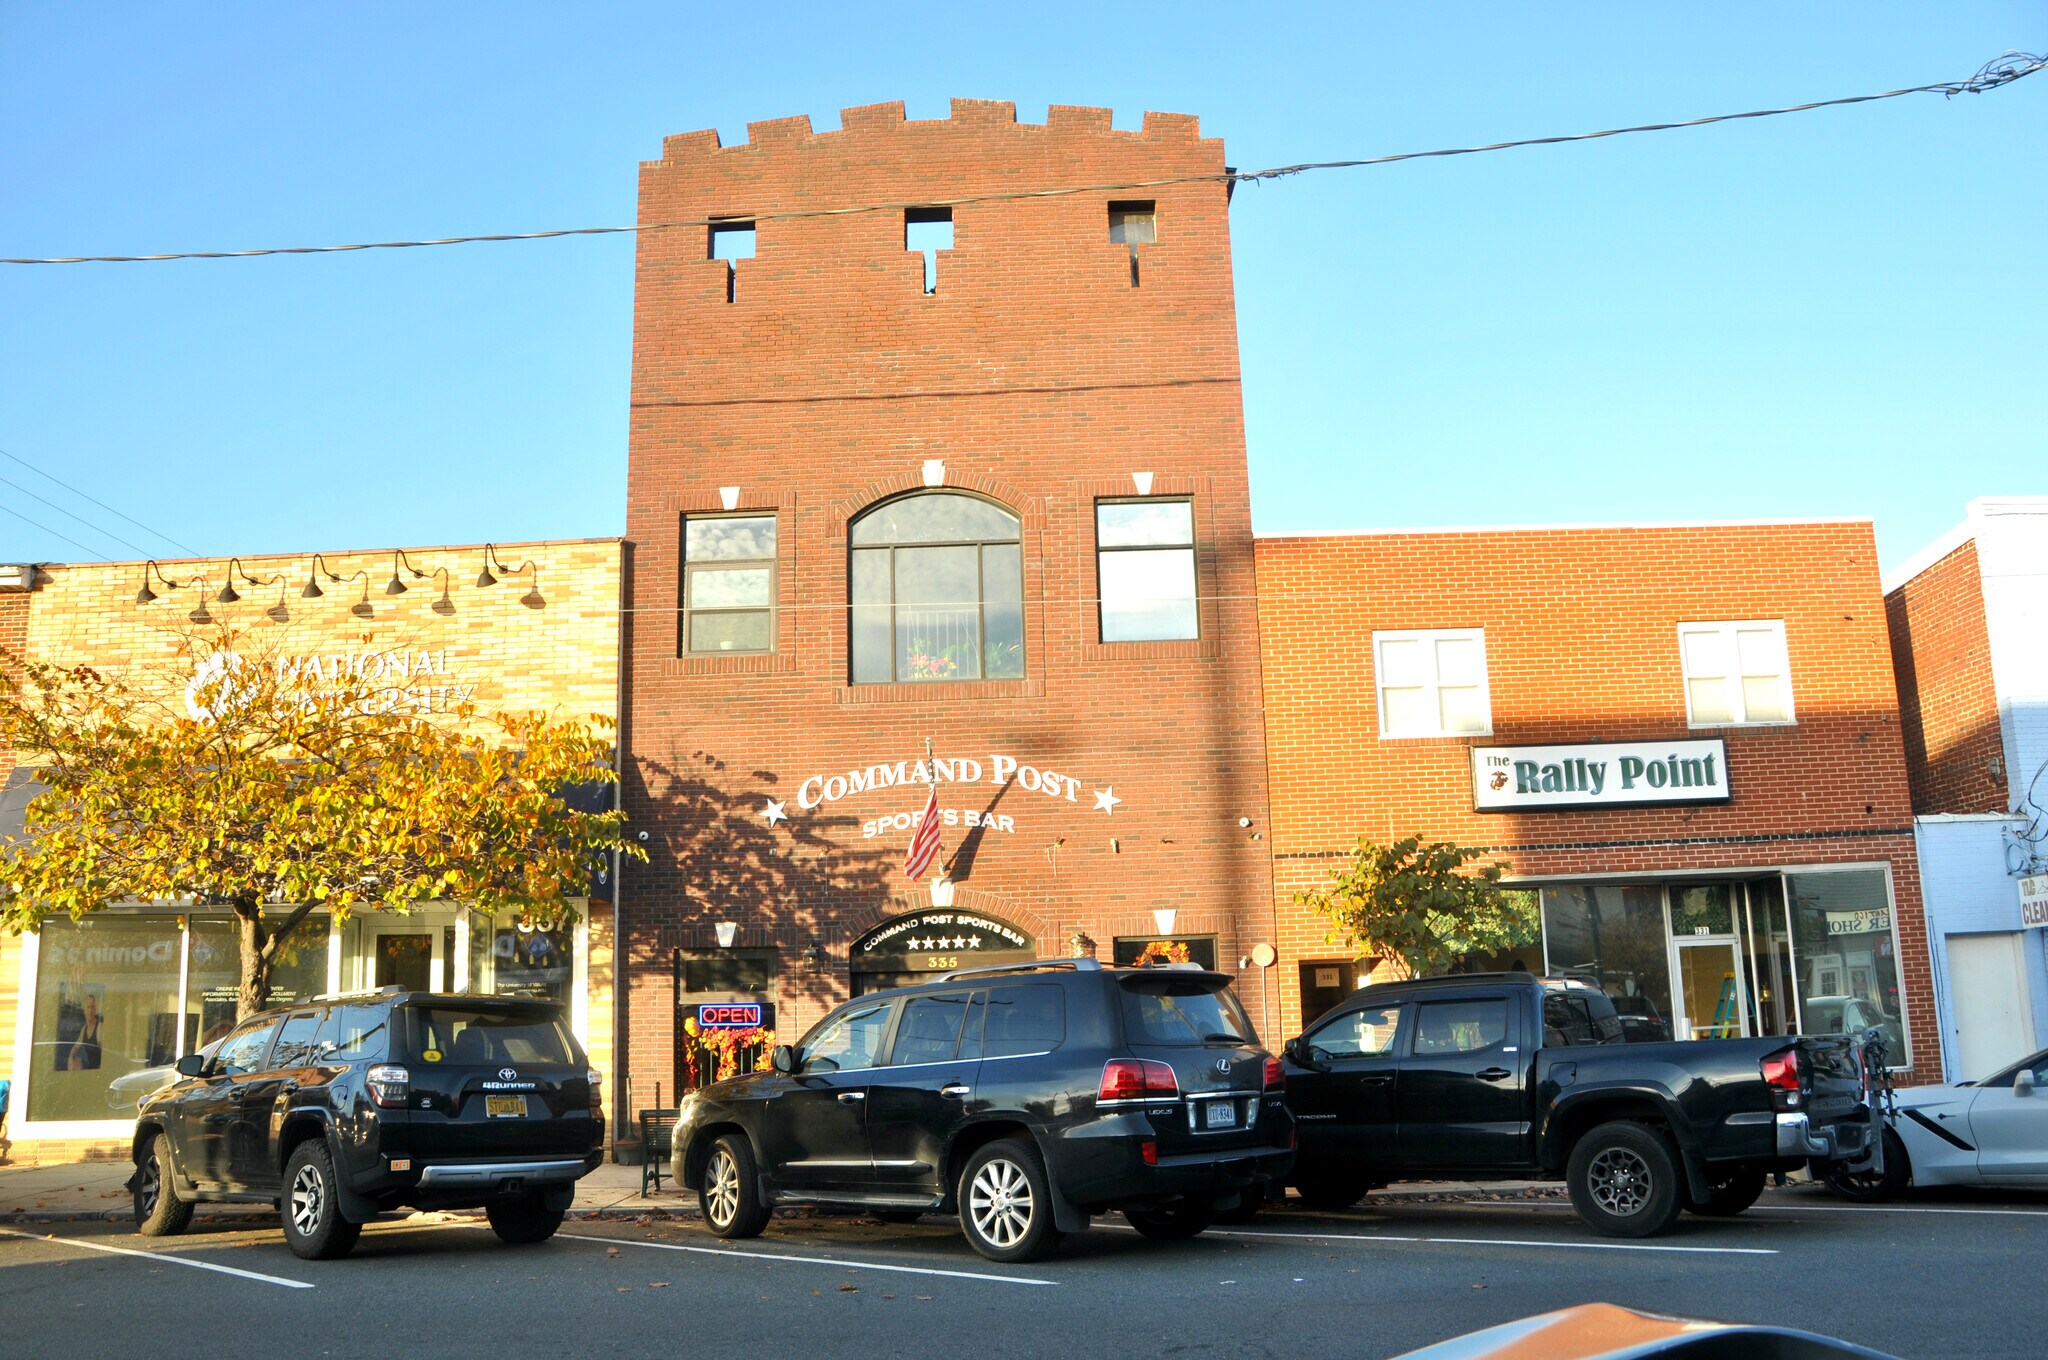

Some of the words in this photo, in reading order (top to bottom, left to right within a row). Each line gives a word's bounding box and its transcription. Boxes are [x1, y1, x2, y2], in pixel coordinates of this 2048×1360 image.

[277, 649, 453, 682] NATIONAL
[275, 684, 476, 717] UNERSITY
[1485, 755, 1510, 767] The
[1513, 757, 1607, 796] Rally
[1618, 751, 1719, 790] Point
[797, 757, 983, 810] COMMAND
[989, 754, 1083, 803] POST
[862, 808, 959, 839] SPORS
[964, 809, 1016, 834] BAR
[2022, 900, 2048, 925] CLEA
[863, 919, 919, 952] COMMAND
[922, 914, 953, 926] POST
[956, 914, 1001, 934] SPORTS
[1001, 925, 1025, 947] BAR
[1696, 927, 1708, 935] 331
[928, 956, 958, 968] 335
[702, 1007, 757, 1023] OPEN
